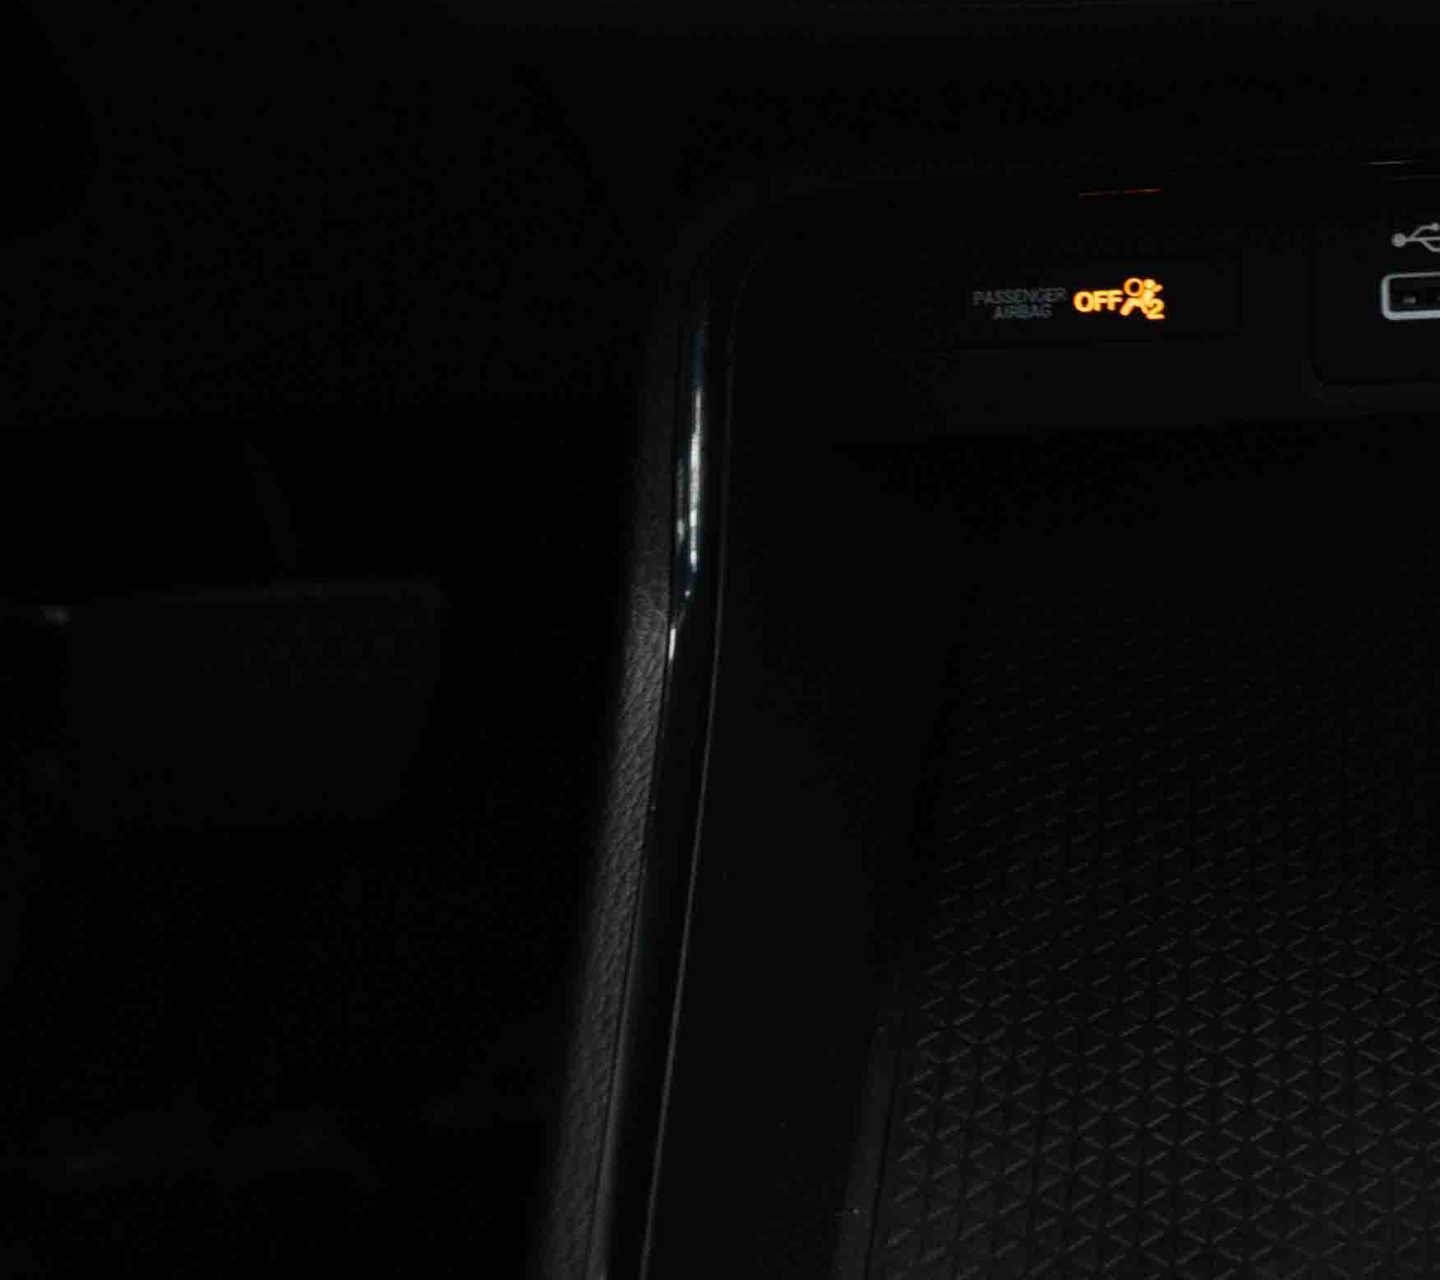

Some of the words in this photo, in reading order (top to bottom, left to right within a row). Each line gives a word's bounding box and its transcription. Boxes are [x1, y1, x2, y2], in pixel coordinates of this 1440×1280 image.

[971, 288, 1067, 307] PASSENGER
[1072, 289, 1124, 313] OFF
[992, 305, 1054, 320] AIRBAG
